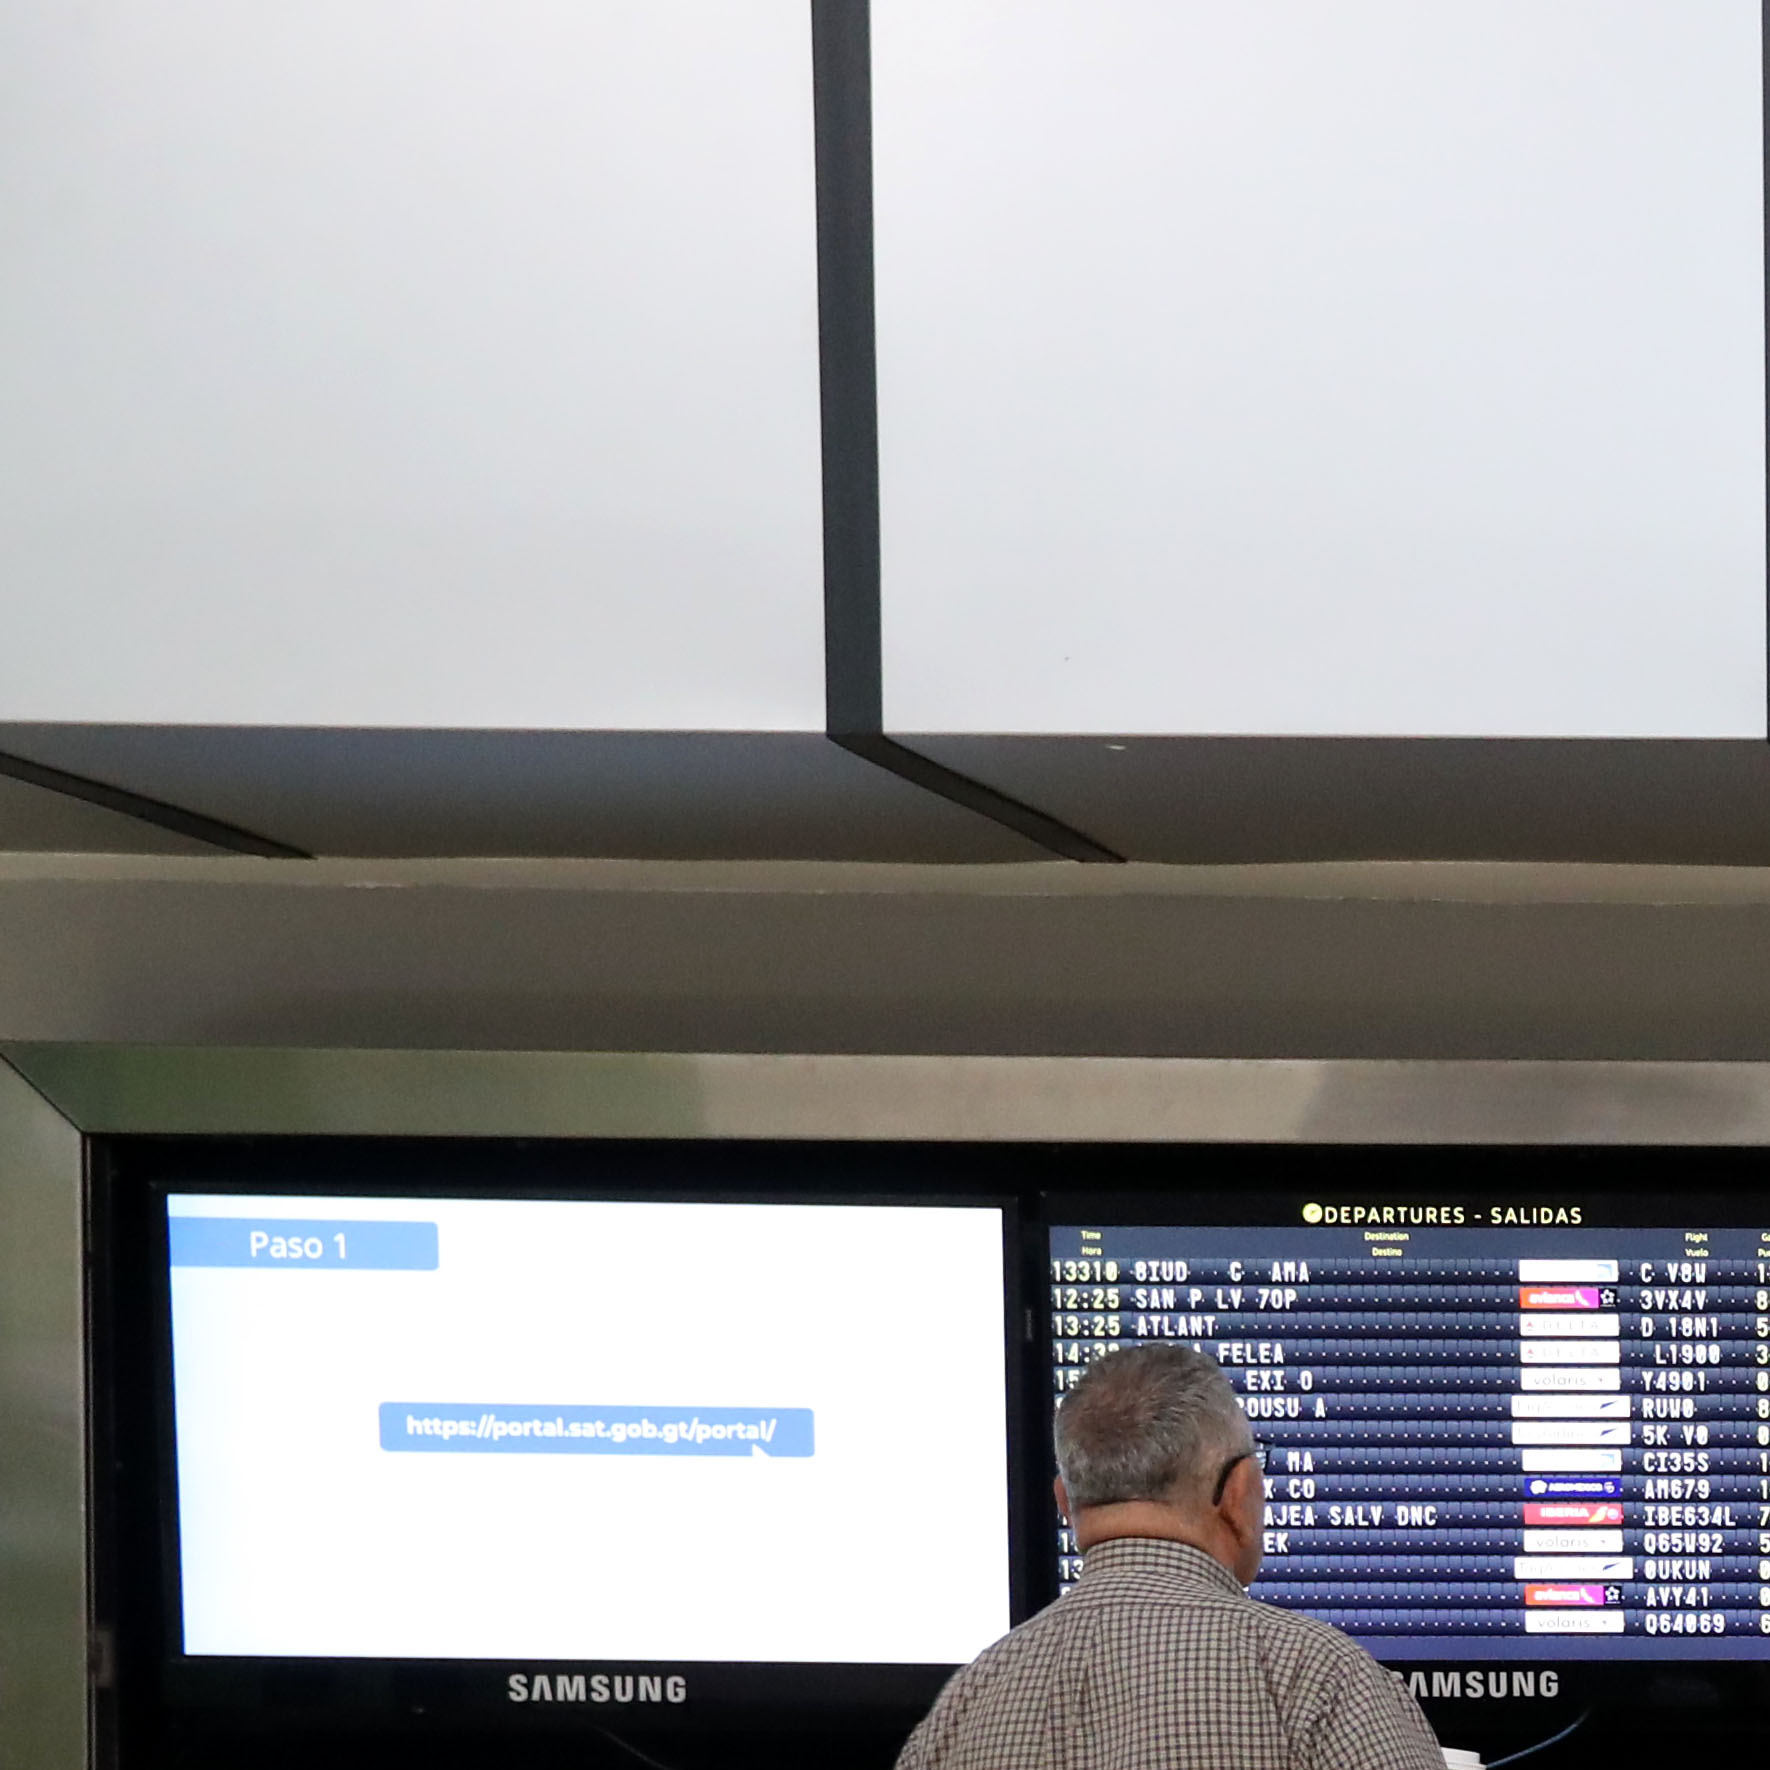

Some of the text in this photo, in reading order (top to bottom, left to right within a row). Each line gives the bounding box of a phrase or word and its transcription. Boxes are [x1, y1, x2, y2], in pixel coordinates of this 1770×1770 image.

[1324, 1206, 1465, 1224] DEPARTURES
[1490, 1206, 1582, 1224] SALIDAS
[249, 1230, 347, 1259] Paso 1
[1080, 1230, 1102, 1240] Time
[1364, 1231, 1409, 1241] Destination
[1685, 1232, 1709, 1243] Flight
[1081, 1246, 1102, 1256] Hora
[1372, 1247, 1402, 1257] Destino
[1685, 1249, 1709, 1258] Vuelo
[1271, 1262, 1310, 1282] AMA
[1640, 1263, 1653, 1283] C
[1054, 1288, 1120, 1310] 12:25
[1135, 1288, 1175, 1310] SAN
[1189, 1288, 1202, 1310] P
[1216, 1289, 1243, 1310] LV
[1054, 1316, 1121, 1336] 13:25
[1136, 1316, 1216, 1337] ATLANT
[1218, 1343, 1284, 1364] FELEA
[1246, 1370, 1285, 1391] EXI
[1534, 1373, 1586, 1386] volaris
[1314, 1398, 1326, 1418] A
[406, 1414, 776, 1445] https://portal.sat.gob.gt/portal/
[1642, 1425, 1668, 1446] 5K
[1288, 1478, 1316, 1499] CO
[1644, 1479, 1710, 1500] AM679
[1329, 1506, 1382, 1526] SALV
[1644, 1506, 1736, 1526] IBE634L
[1536, 1535, 1589, 1548] volaris
[1538, 1616, 1590, 1629] volaris
[507, 1673, 688, 1705] SAMSUNG
